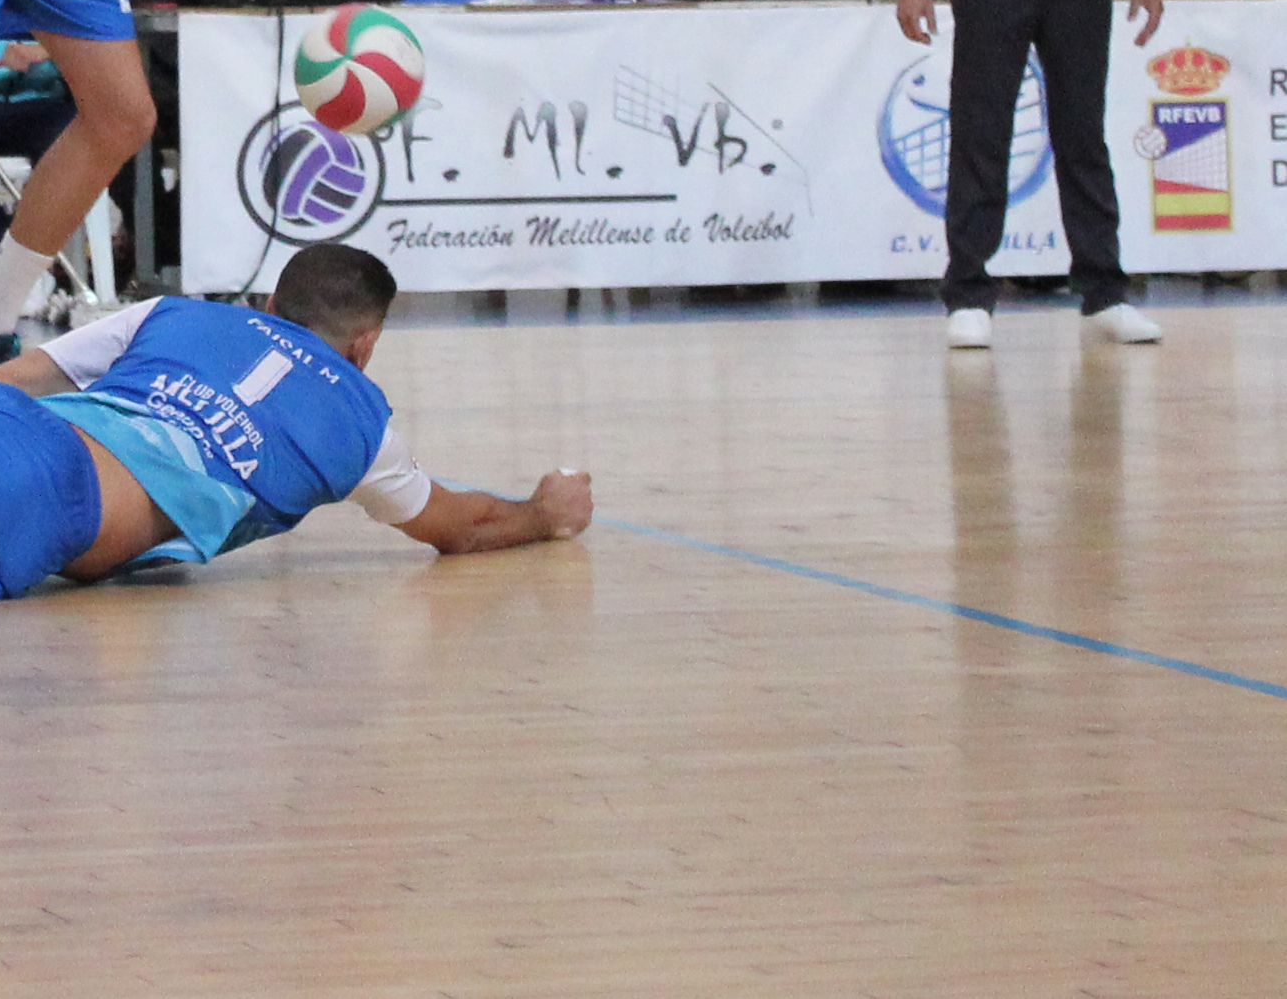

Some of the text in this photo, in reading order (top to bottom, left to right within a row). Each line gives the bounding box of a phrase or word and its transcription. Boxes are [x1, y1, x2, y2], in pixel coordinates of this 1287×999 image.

[1158, 106, 1222, 124] RFEVB
[386, 212, 796, 255] Federación Melillense de Voleibol
[1002, 229, 1059, 253] ILLA
[230, 345, 295, 407] 1
[178, 373, 265, 452] CLUB VOLEIBOL
